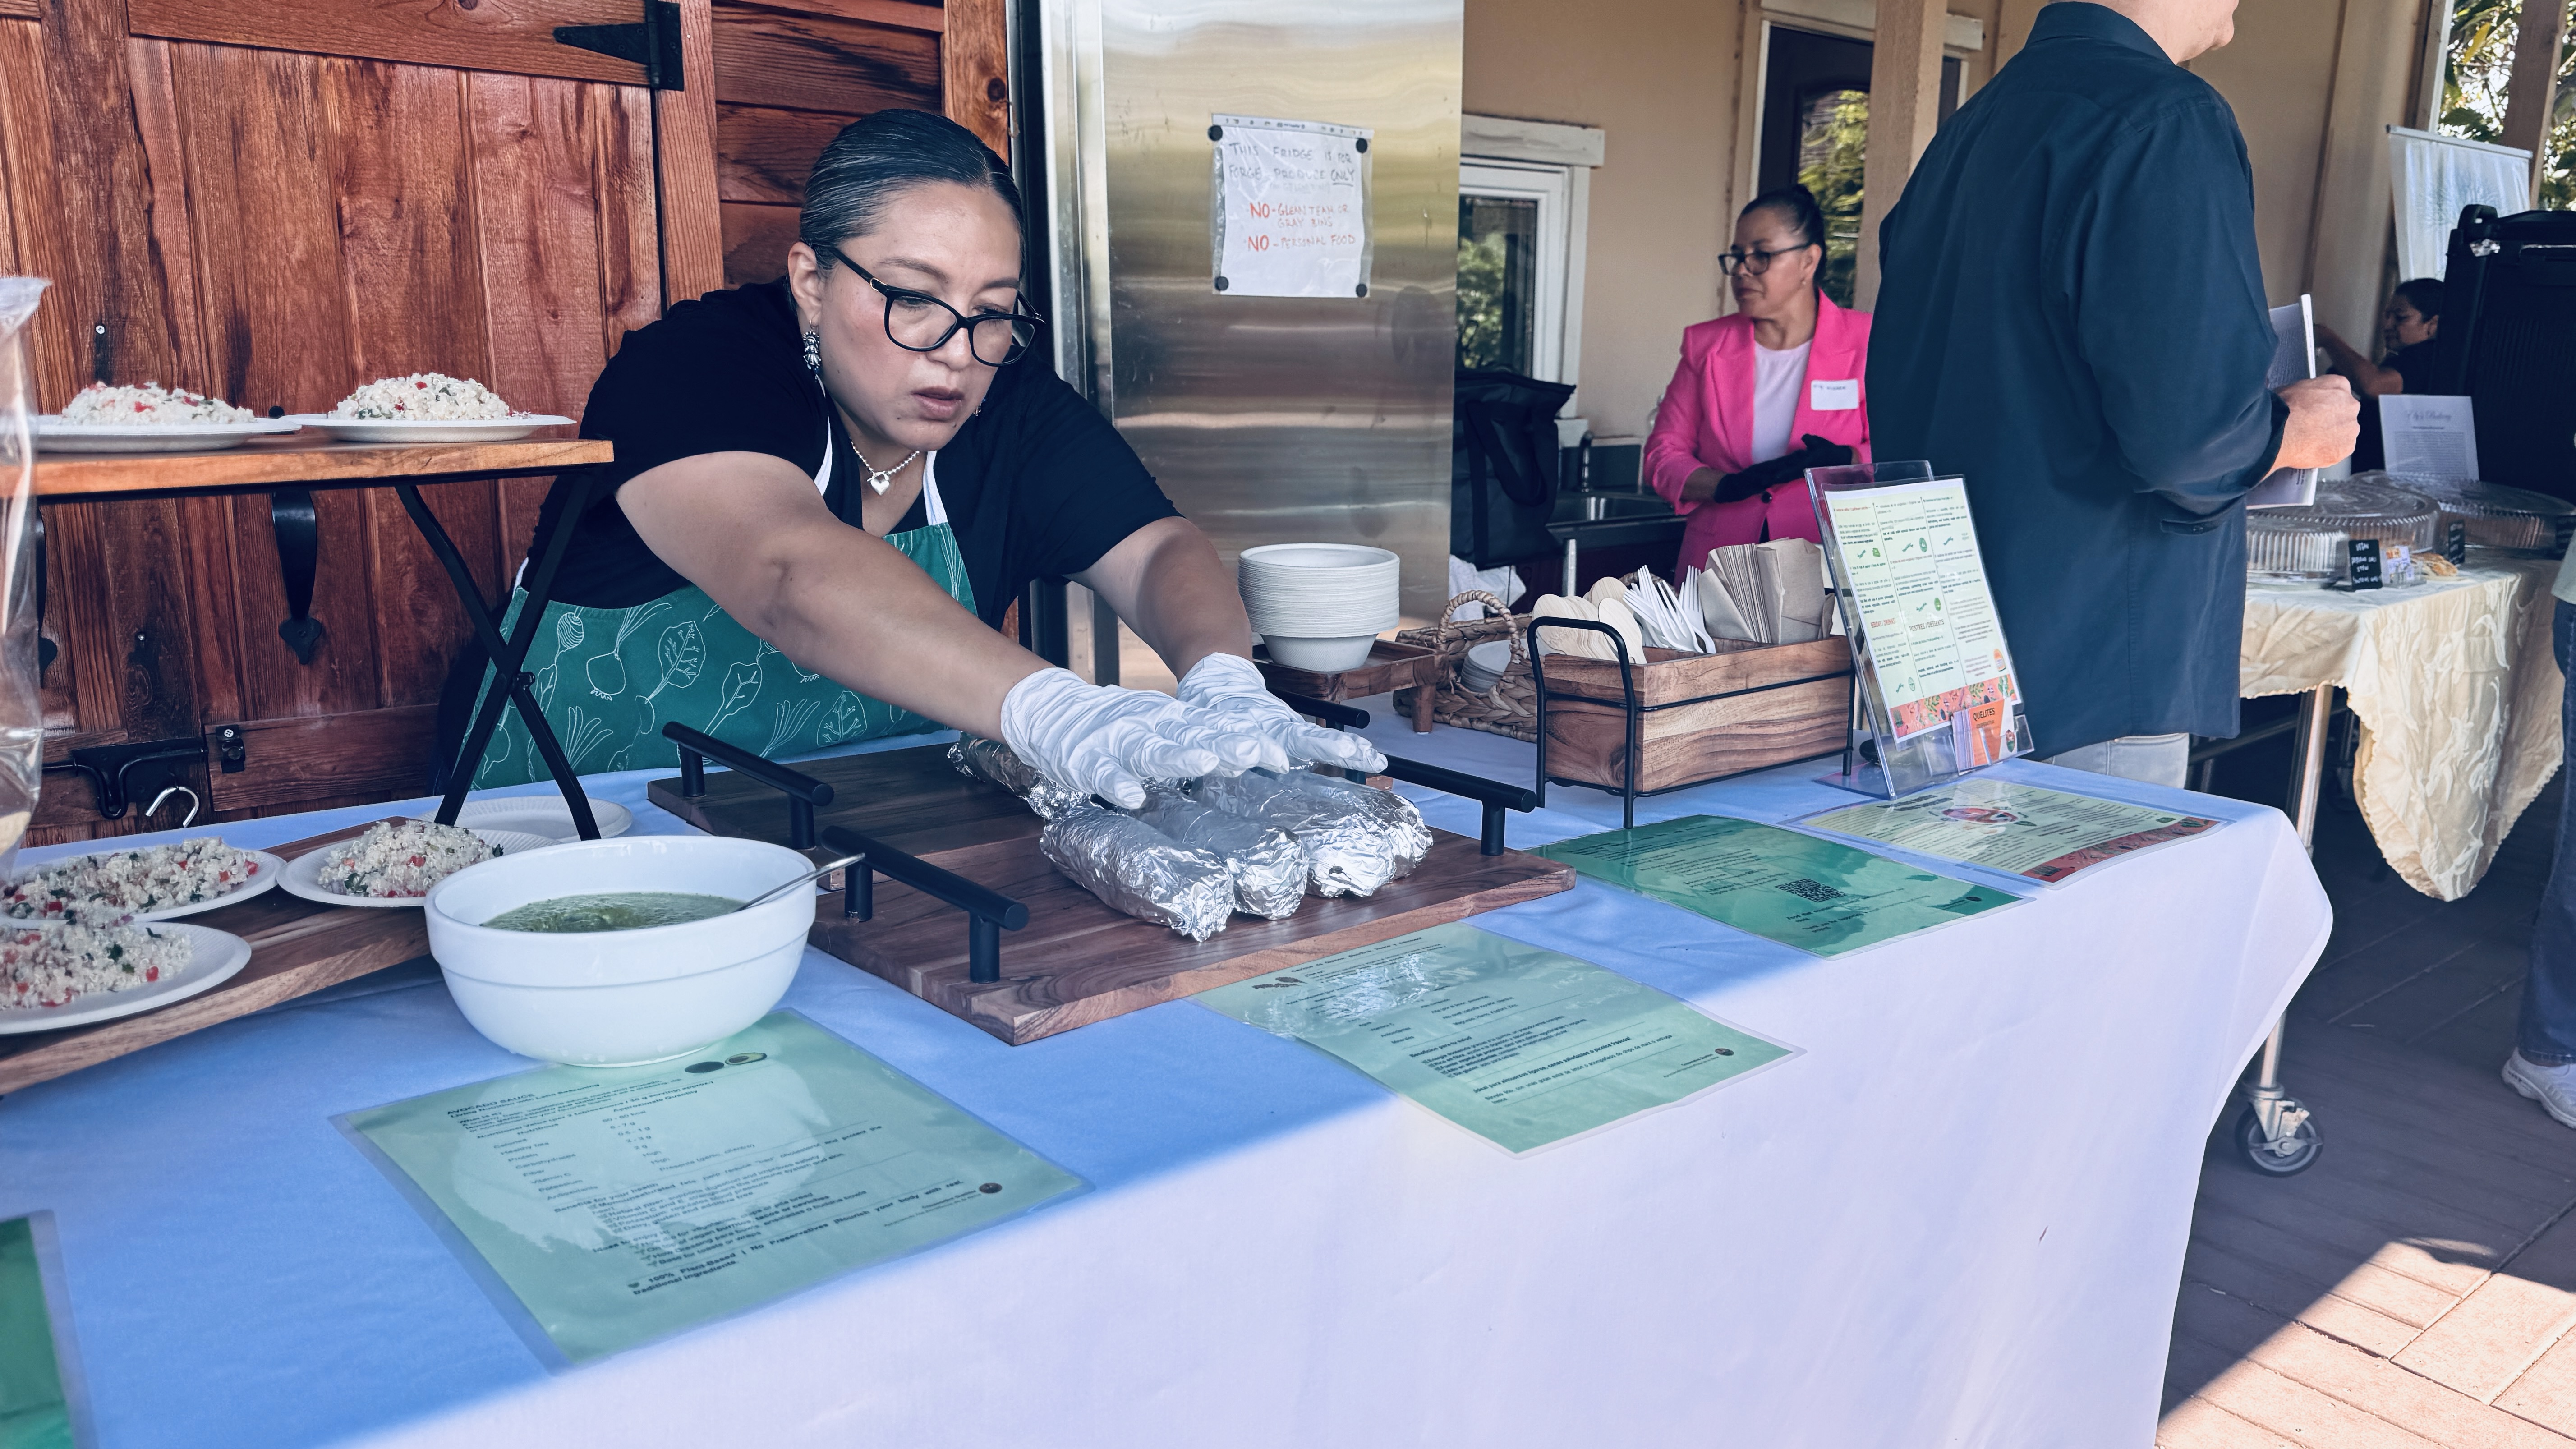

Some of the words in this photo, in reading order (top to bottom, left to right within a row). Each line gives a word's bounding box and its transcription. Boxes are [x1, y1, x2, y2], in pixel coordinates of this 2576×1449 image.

[1229, 143, 1259, 156] THIS
[1273, 147, 1313, 161] FRIDGE
[1274, 167, 1326, 180] PRODUCE
[1331, 169, 1355, 181] ONLY
[1330, 232, 1356, 244] FOOD
[1909, 623, 1925, 631] POSTRES
[1928, 619, 1944, 629] DESSERTS
[1973, 708, 1995, 721] QUELITES
[447, 1101, 497, 1115] AVOCADO
[500, 1093, 534, 1103] SAUCE
